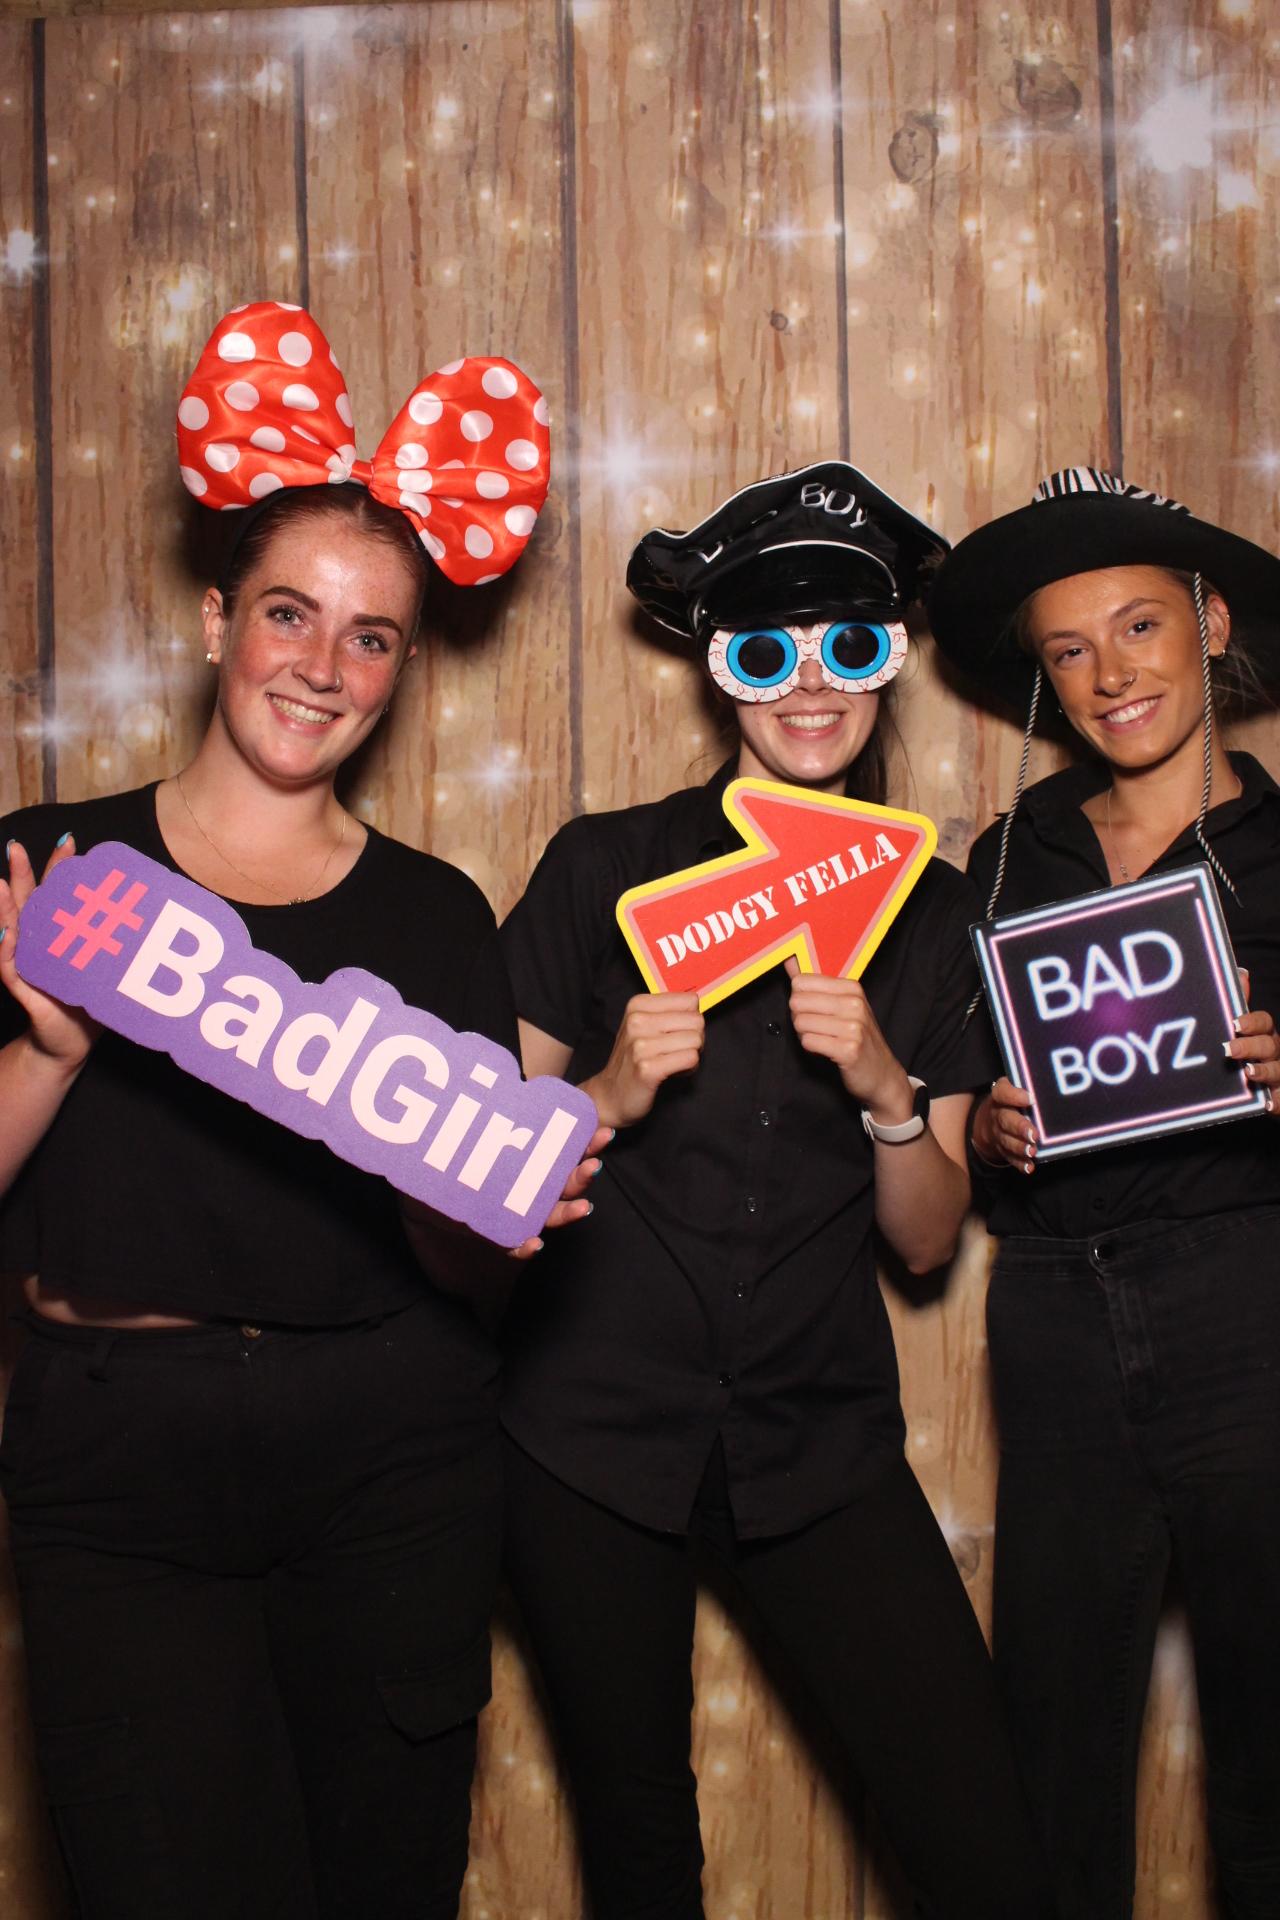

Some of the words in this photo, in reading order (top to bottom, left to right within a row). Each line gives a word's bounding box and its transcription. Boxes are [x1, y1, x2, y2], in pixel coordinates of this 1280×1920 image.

[656, 886, 779, 967] DODGY
[784, 832, 901, 907] FELLA
[1027, 930, 1183, 1021] BAD
[47, 868, 578, 1217] #BadGirl
[1051, 1017, 1208, 1095] BOYZ
